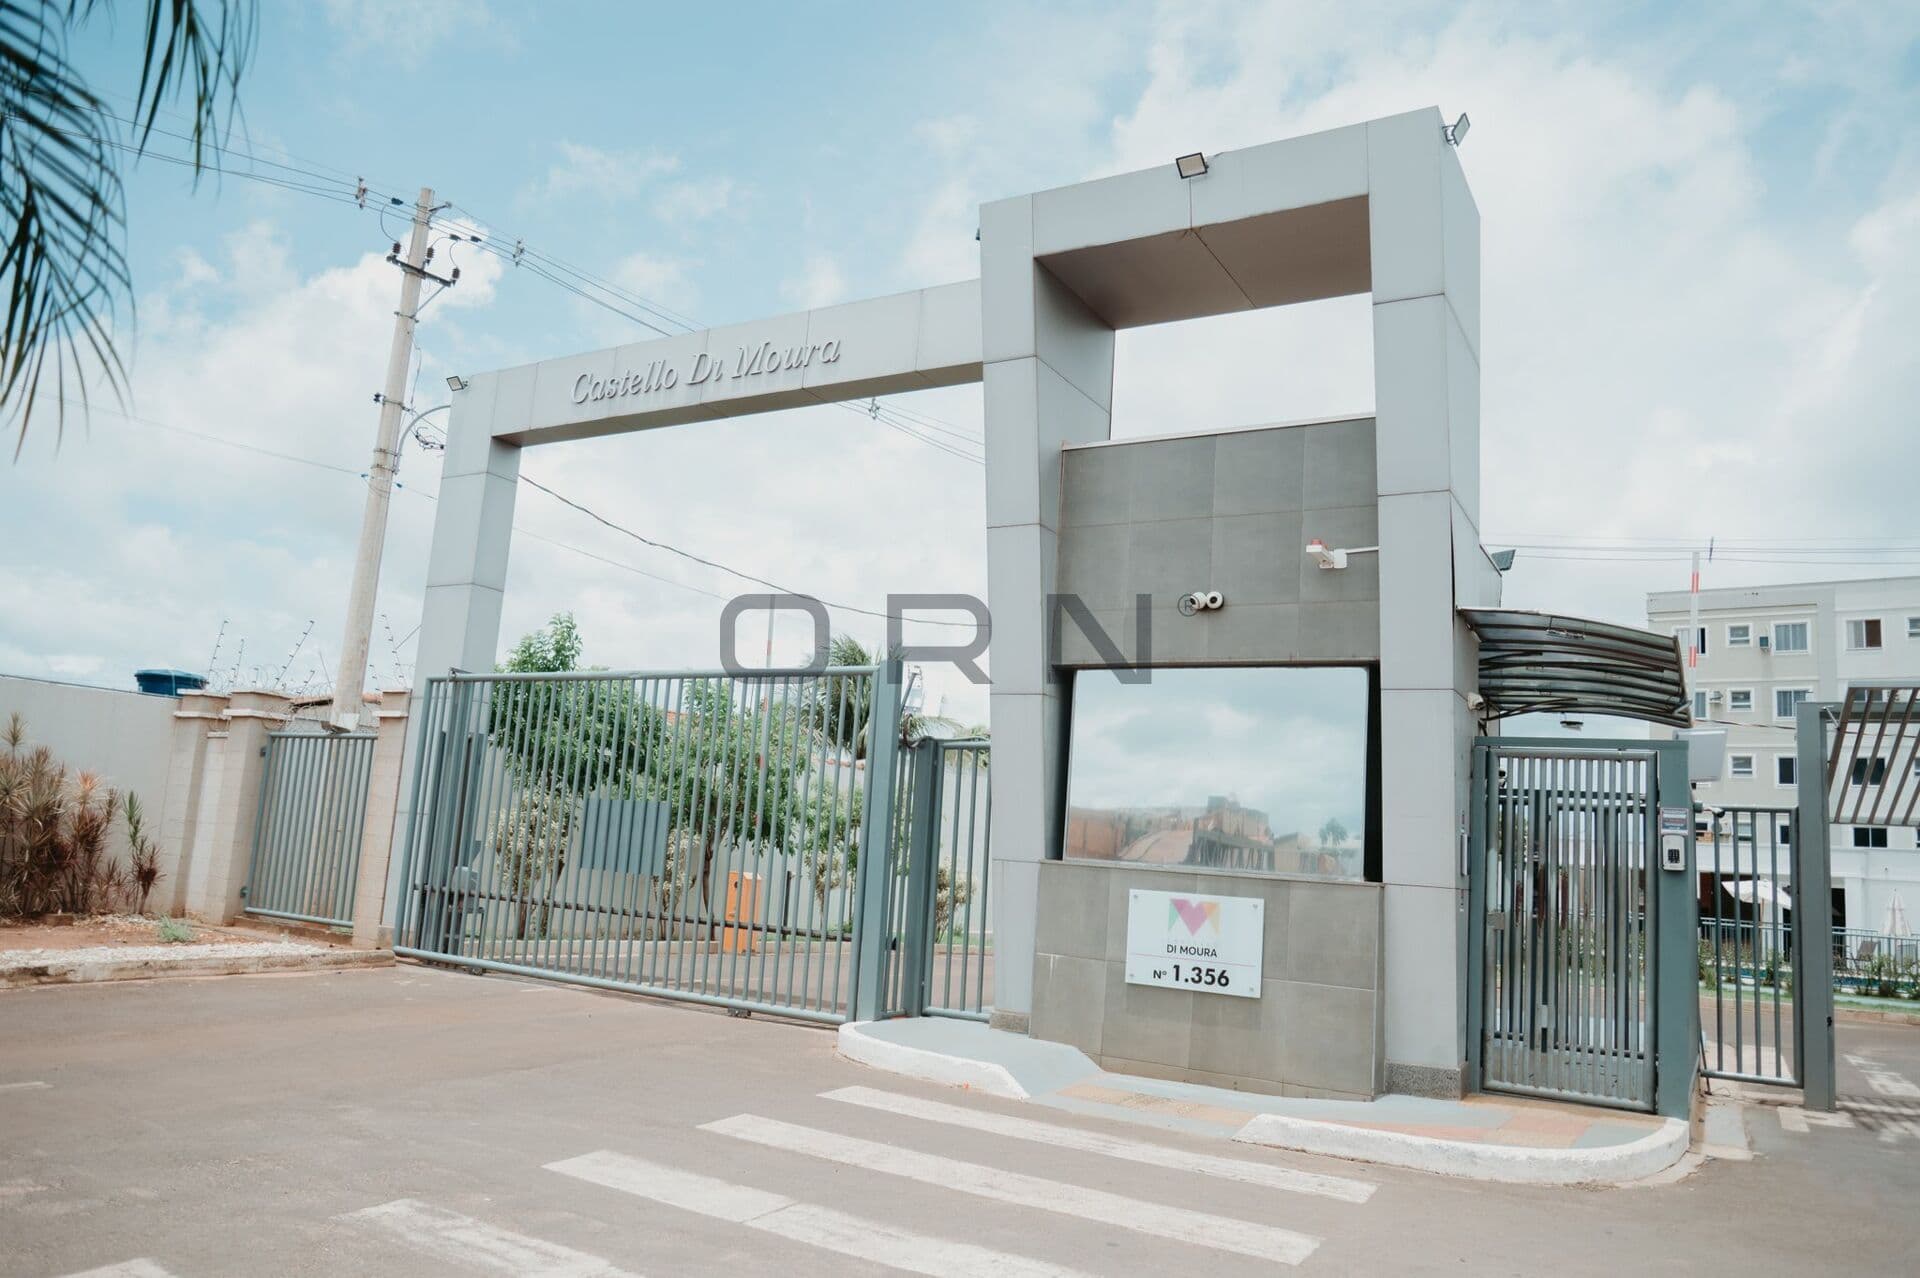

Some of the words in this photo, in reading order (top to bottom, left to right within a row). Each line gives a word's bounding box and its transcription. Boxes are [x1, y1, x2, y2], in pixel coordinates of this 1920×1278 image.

[571, 359, 680, 405] Castello
[686, 352, 724, 386] Di
[731, 339, 842, 379] Moura
[1166, 944, 1177, 954] DI
[1179, 945, 1218, 958] MOURA
[1173, 964, 1230, 987] 1.356
